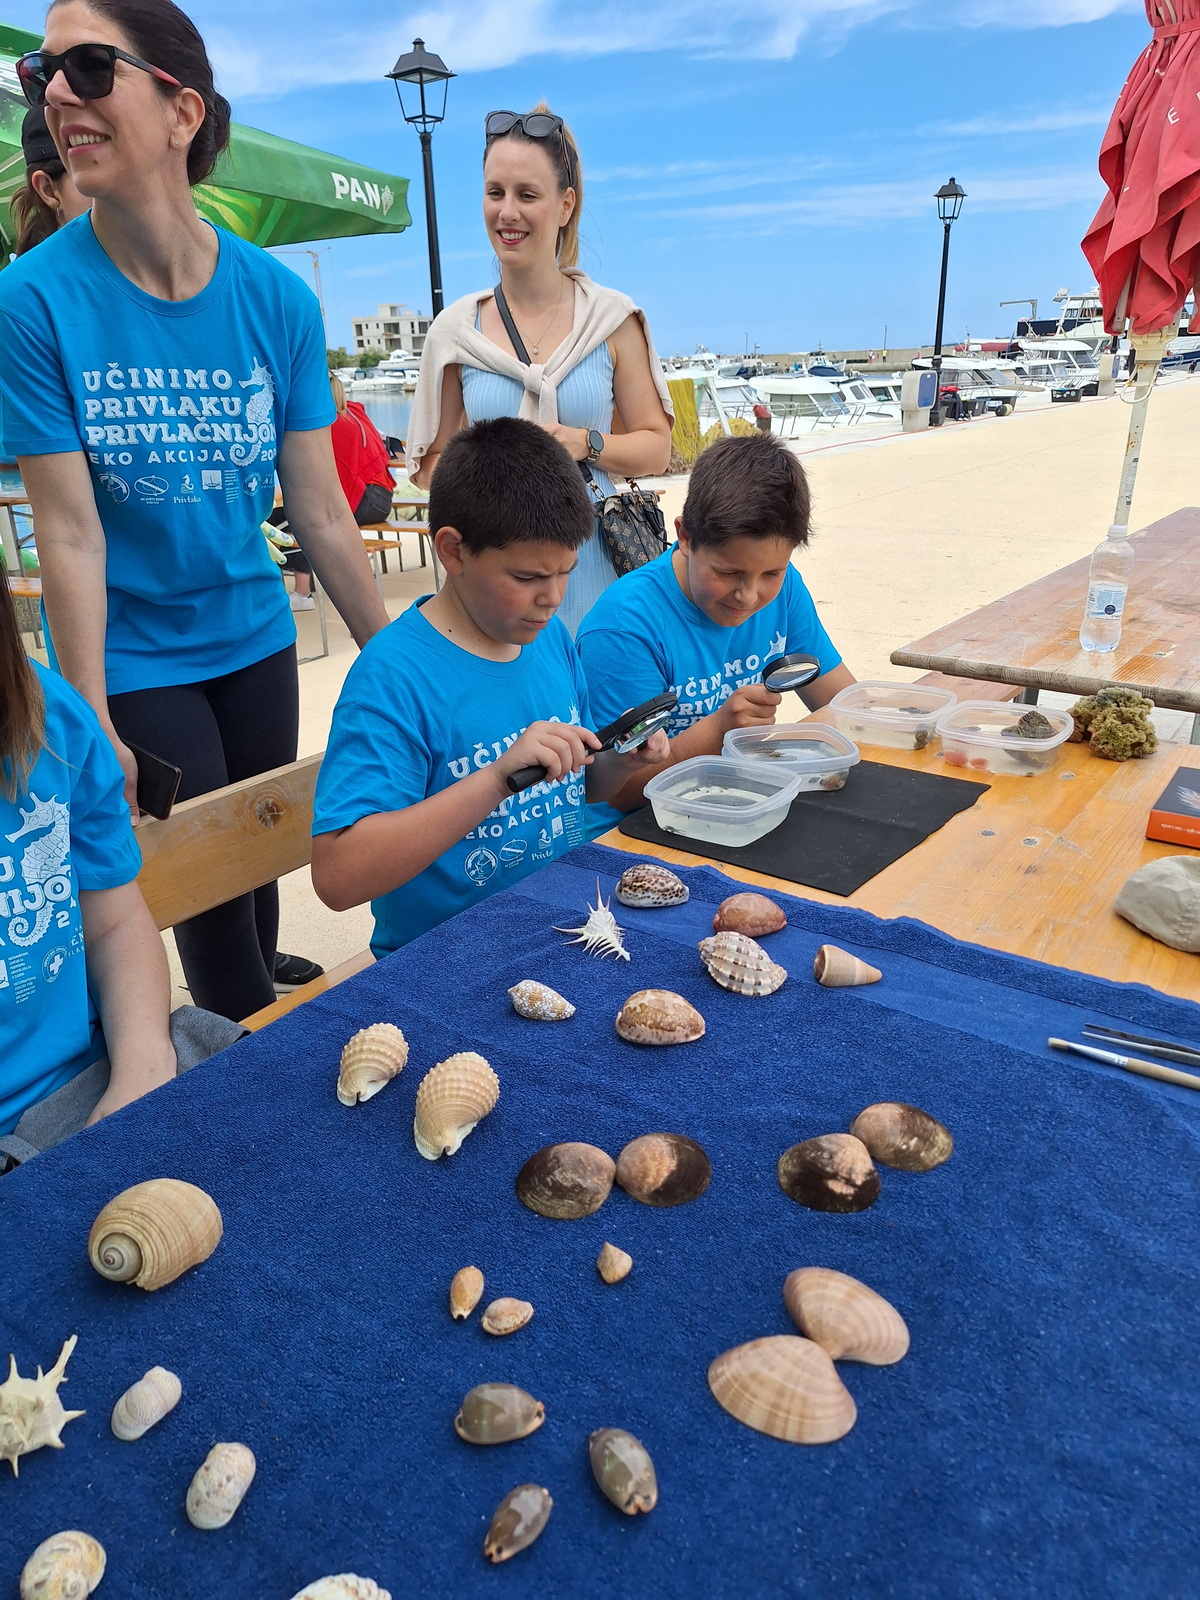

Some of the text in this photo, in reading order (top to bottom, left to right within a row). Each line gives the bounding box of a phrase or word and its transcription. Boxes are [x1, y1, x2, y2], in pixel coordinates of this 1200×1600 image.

[330, 171, 381, 210] PAN
[82, 362, 233, 392] UČINIMO
[84, 395, 242, 420] PRIVLAKU
[89, 449, 226, 465] EKO AKCIJA
